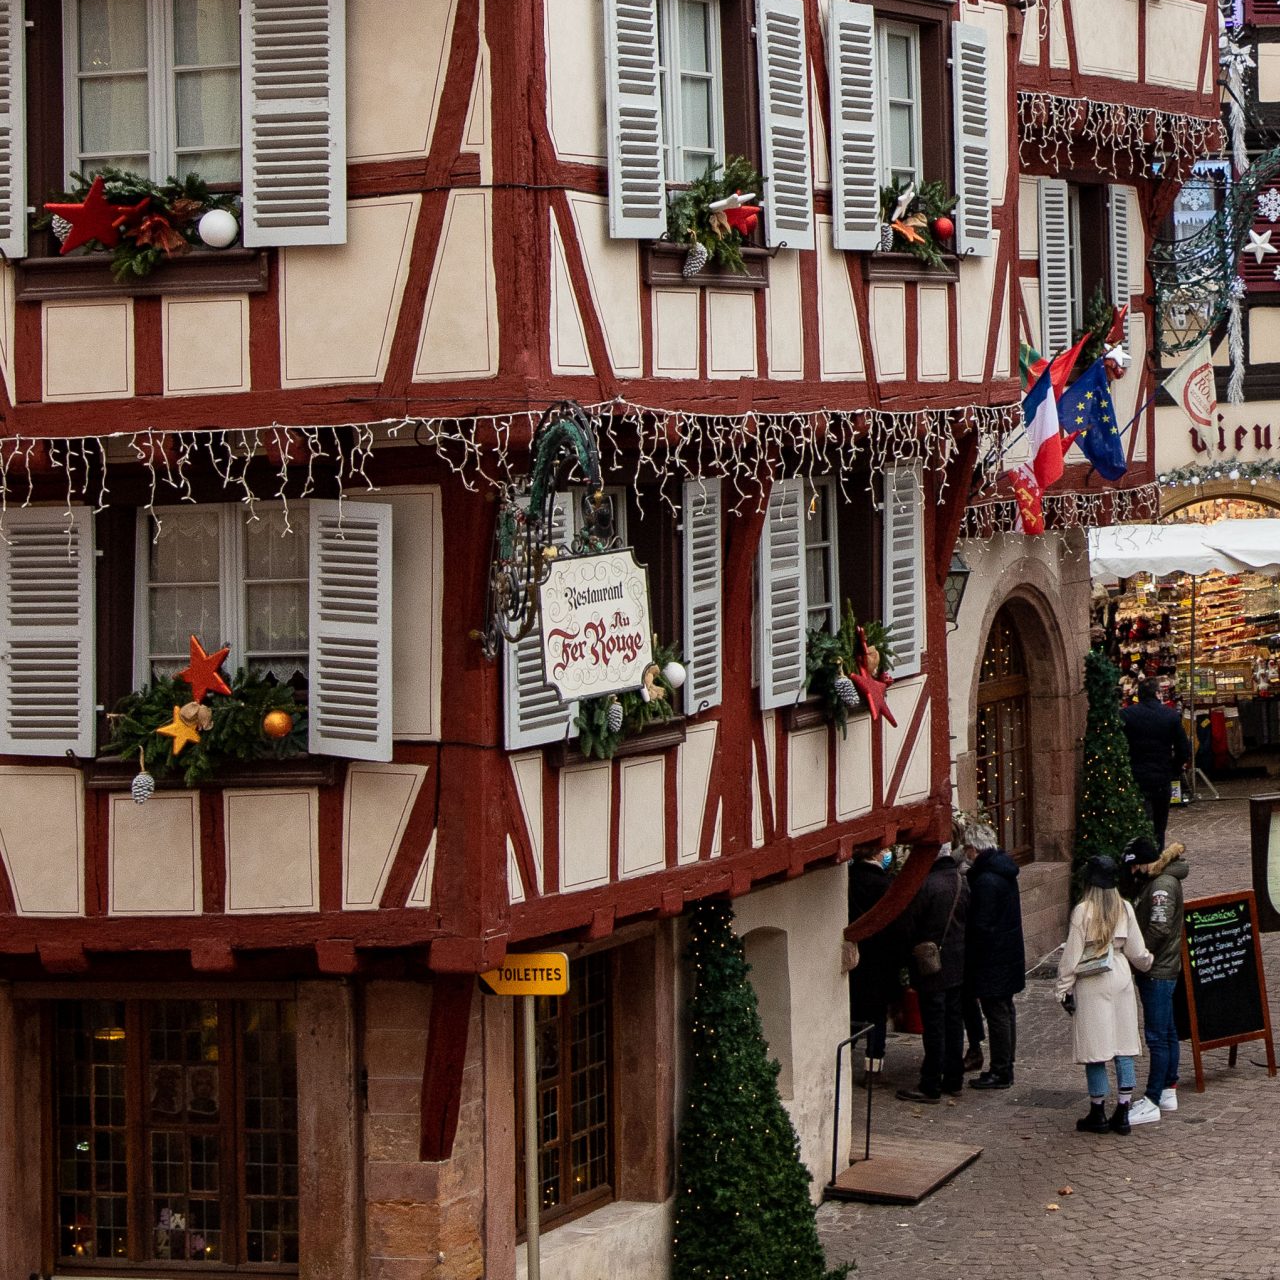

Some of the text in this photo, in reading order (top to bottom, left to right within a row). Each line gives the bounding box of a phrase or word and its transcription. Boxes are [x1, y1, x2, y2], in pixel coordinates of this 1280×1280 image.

[564, 581, 624, 612] Restaurant
[610, 611, 630, 630] Au
[547, 617, 644, 673] Fer Rouge
[497, 967, 562, 982] TOILETTES
